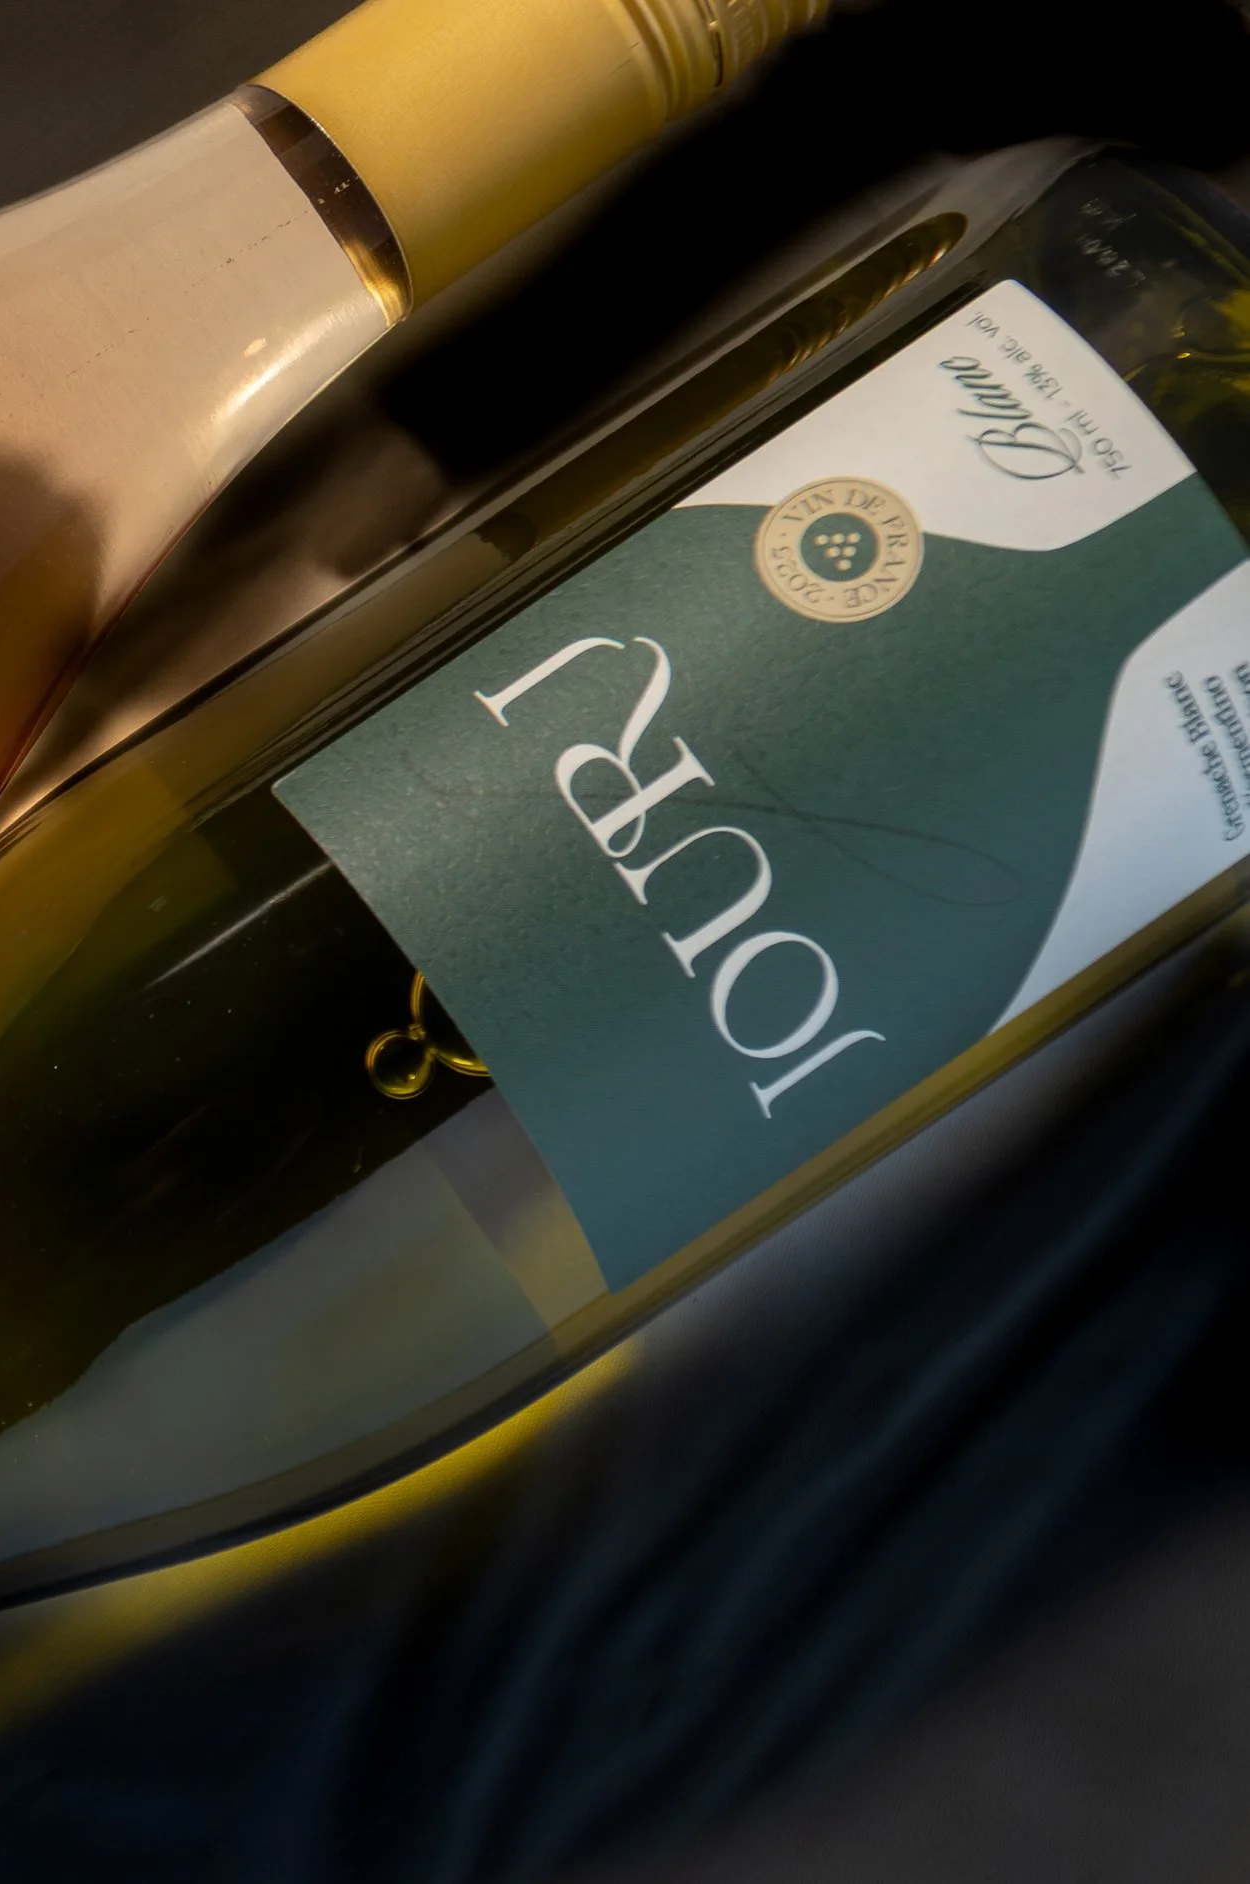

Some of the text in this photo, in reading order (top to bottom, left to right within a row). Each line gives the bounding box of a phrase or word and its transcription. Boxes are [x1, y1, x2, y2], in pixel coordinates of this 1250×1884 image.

[1023, 363, 1063, 399] 13%
[938, 356, 1086, 480] Blanc
[1066, 408, 1099, 435] ml
[1092, 437, 1132, 480] 750
[781, 489, 835, 521] VIN
[844, 489, 885, 515] DE
[843, 515, 910, 609] FRANCE
[1162, 670, 1246, 842] Grenache Blanc
[1203, 674, 1250, 806] mentino
